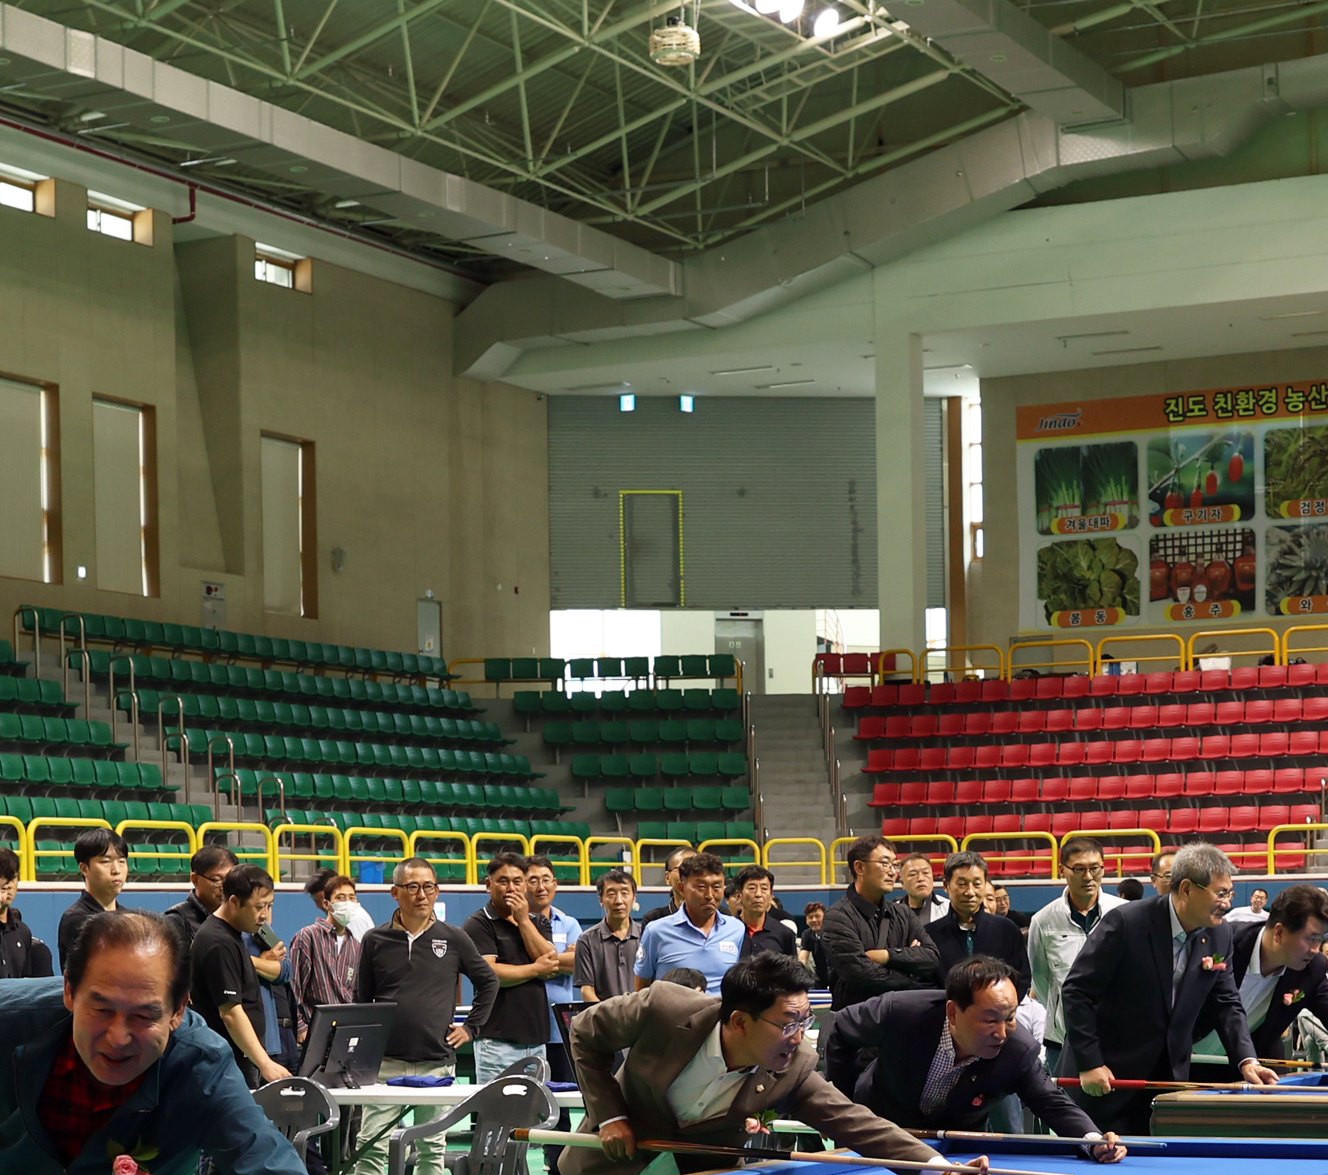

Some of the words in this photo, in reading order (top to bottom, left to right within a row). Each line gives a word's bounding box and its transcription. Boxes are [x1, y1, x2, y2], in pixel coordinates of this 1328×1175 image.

[1164, 395, 1208, 422] 진도
[1213, 387, 1279, 418] 친환경
[1035, 411, 1080, 432] Jindo
[1065, 516, 1111, 531] 겨울대파
[1182, 508, 1222, 522] 구기자
